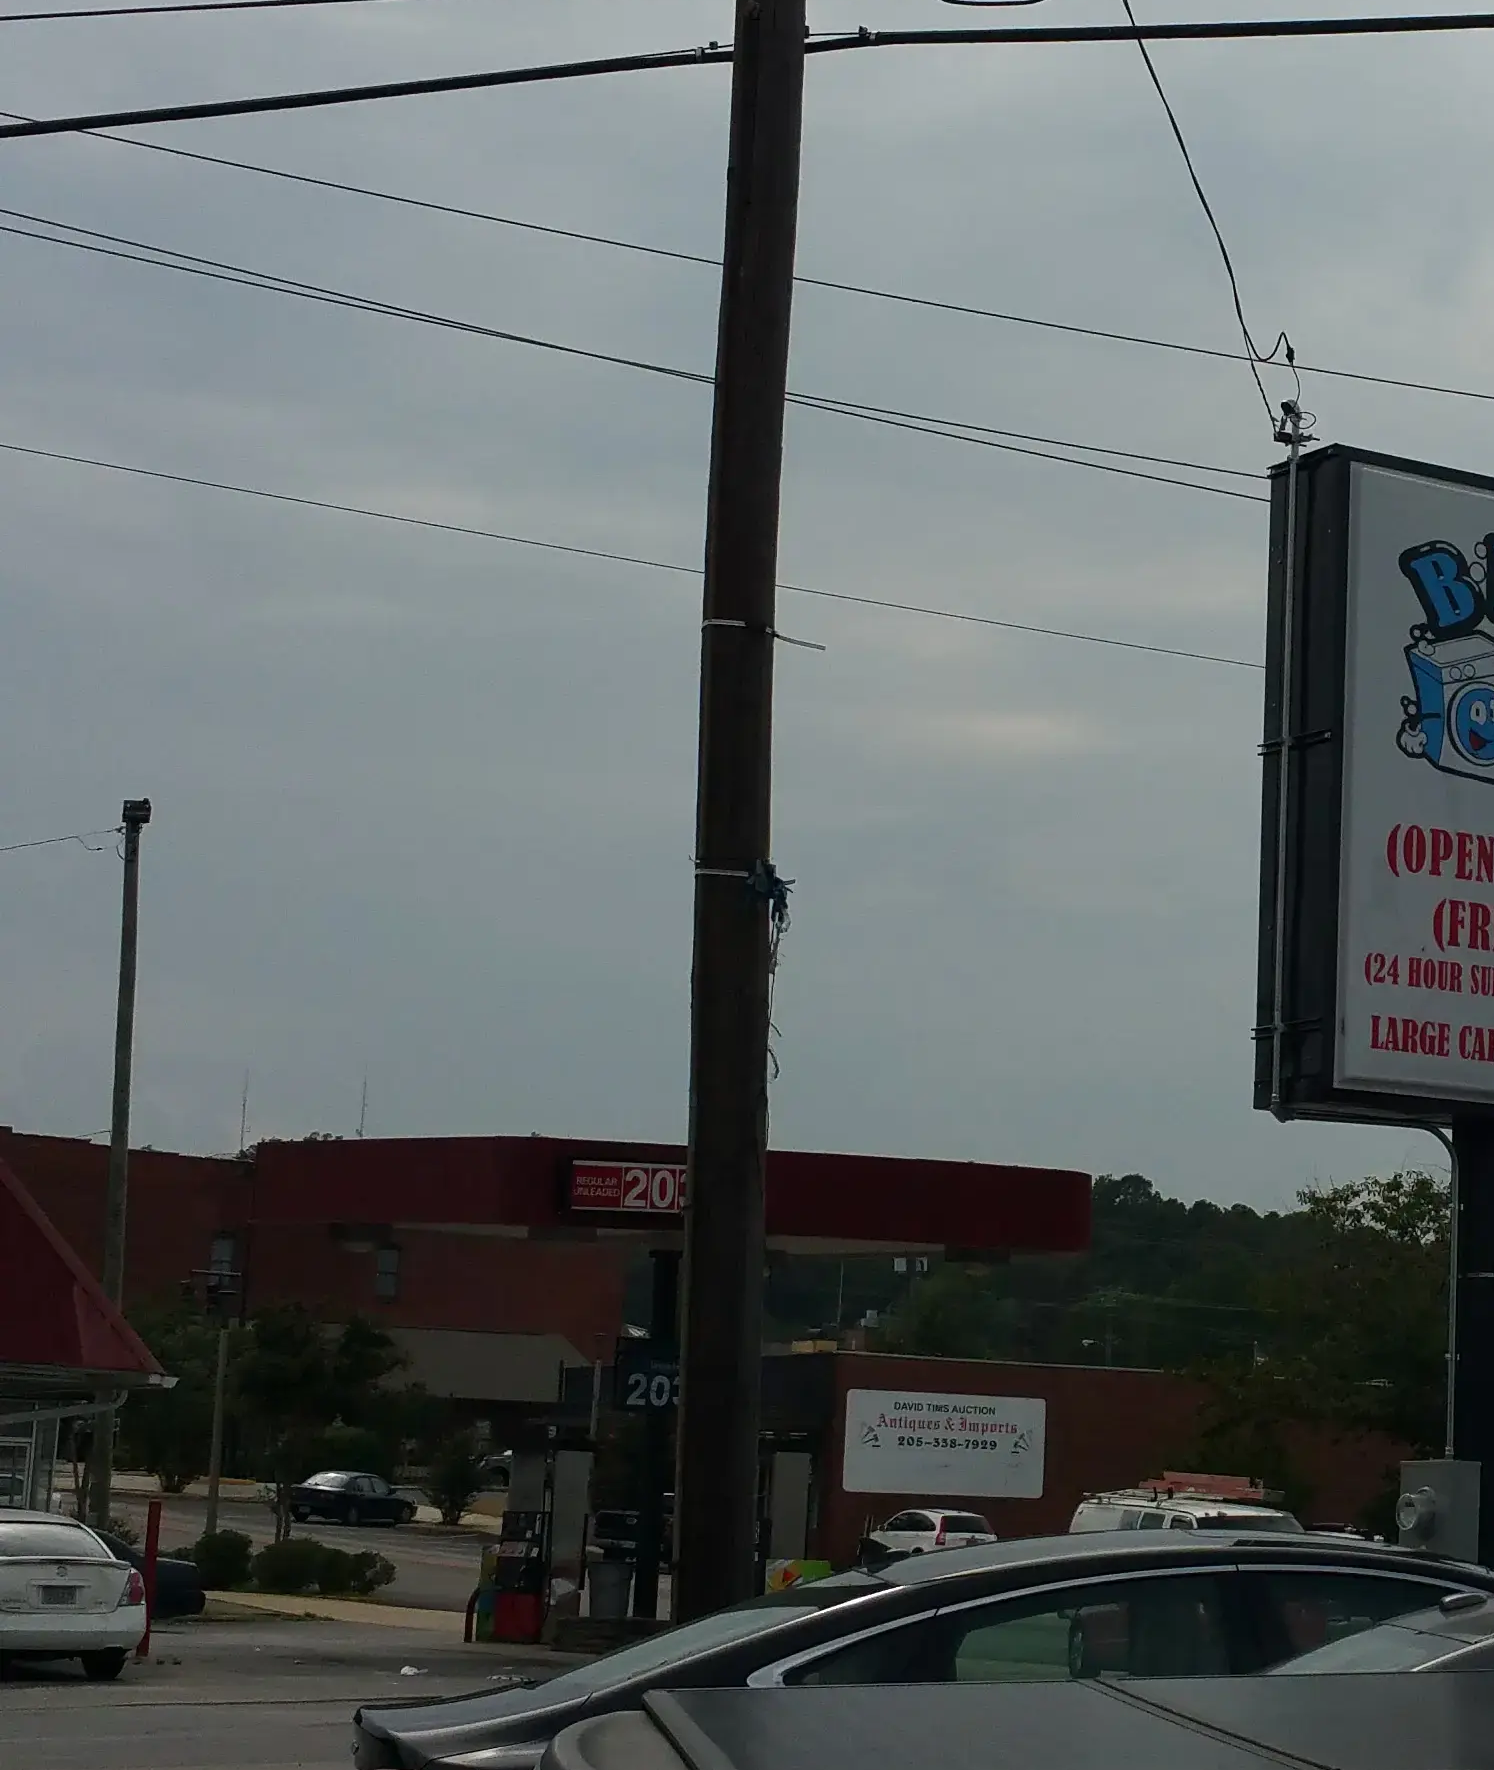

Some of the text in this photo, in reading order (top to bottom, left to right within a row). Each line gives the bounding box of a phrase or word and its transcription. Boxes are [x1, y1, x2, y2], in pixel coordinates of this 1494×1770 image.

[1364, 952, 1401, 987] (24
[1407, 956, 1464, 993] HOUR
[1369, 1014, 1451, 1058] LARGE
[576, 1175, 618, 1186] REGULAR
[572, 1186, 621, 1198] UNLEADED
[893, 1401, 924, 1412] DAVID
[951, 1405, 996, 1416] AUCTION
[876, 1413, 1018, 1436] Antiques & Imports
[897, 1435, 998, 1451] 205-338-7929
